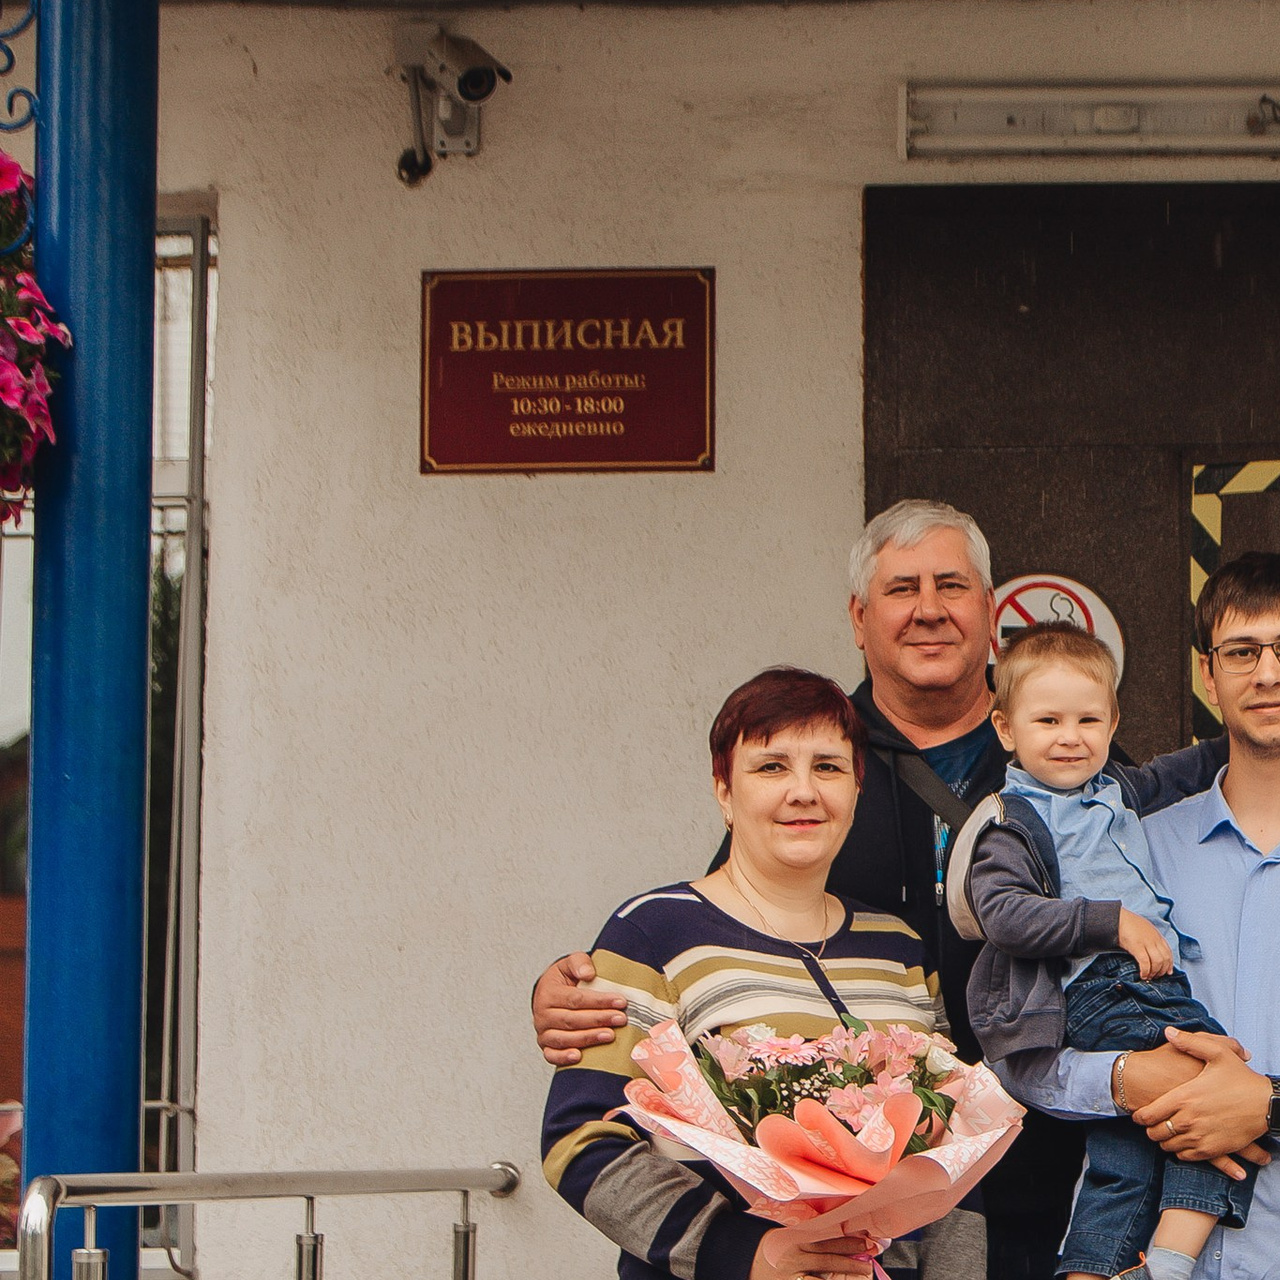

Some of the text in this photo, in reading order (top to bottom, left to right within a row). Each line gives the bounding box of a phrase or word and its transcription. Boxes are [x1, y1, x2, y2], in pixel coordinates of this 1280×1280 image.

[450, 318, 686, 352] ВЫПИСНАЯ
[492, 371, 646, 391] Режим работы:
[511, 397, 561, 415] 10:30
[576, 396, 625, 414] 18:00
[509, 421, 625, 439] ежедневно
